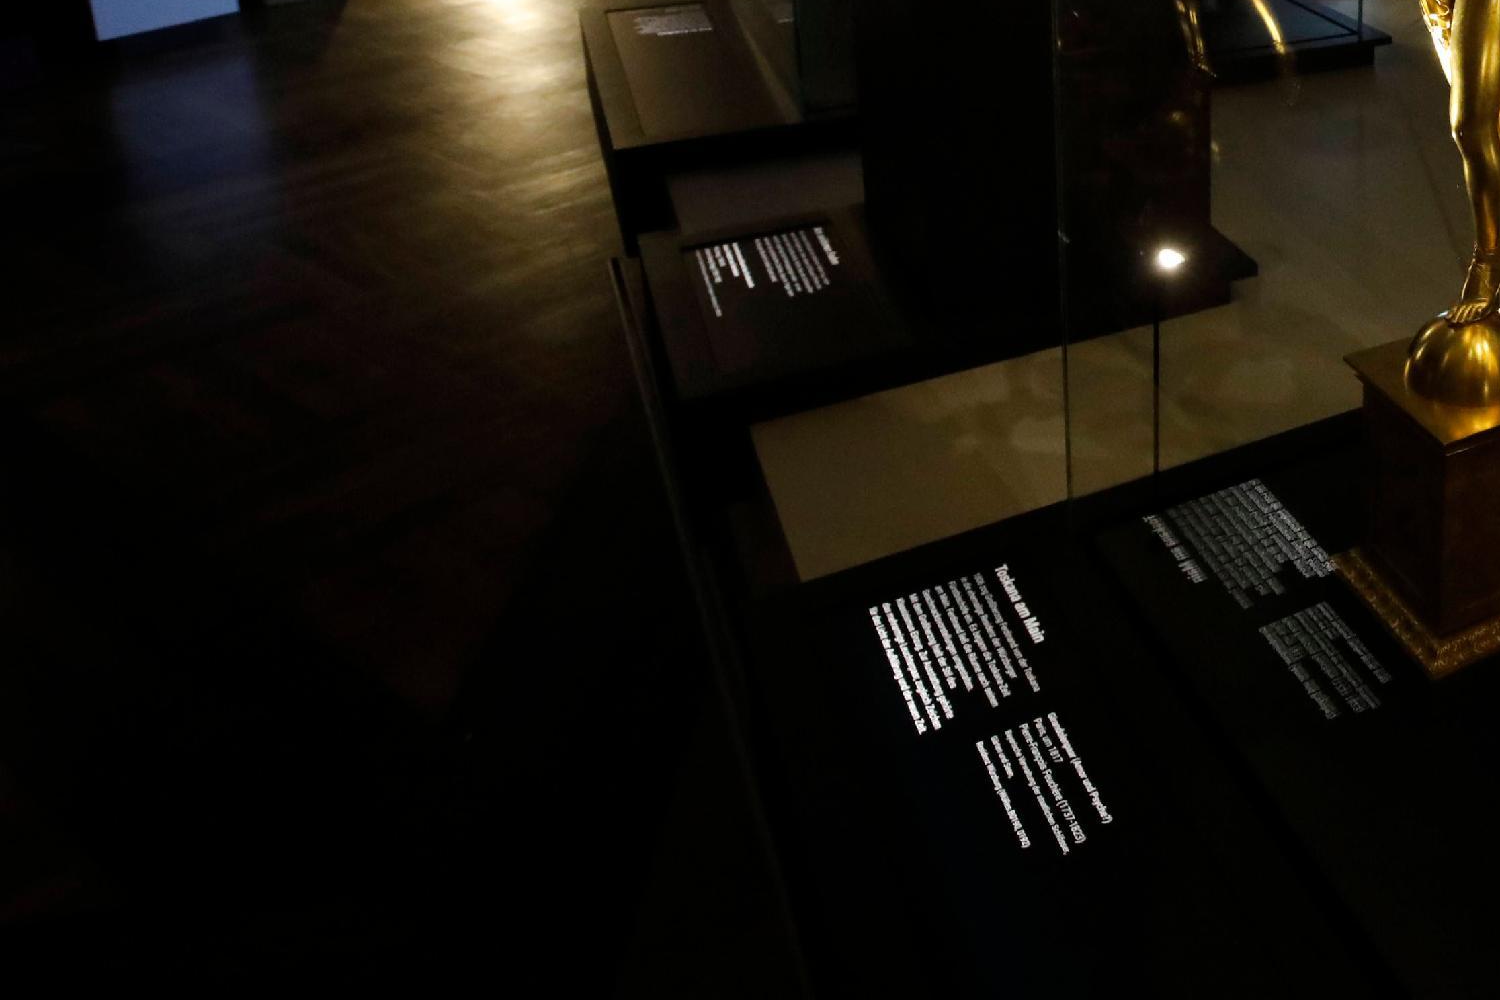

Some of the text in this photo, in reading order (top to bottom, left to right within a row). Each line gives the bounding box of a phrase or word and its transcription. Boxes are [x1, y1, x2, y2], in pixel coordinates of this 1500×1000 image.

[995, 564, 1045, 644] Toskana am Main
[1040, 735, 1053, 747] um
